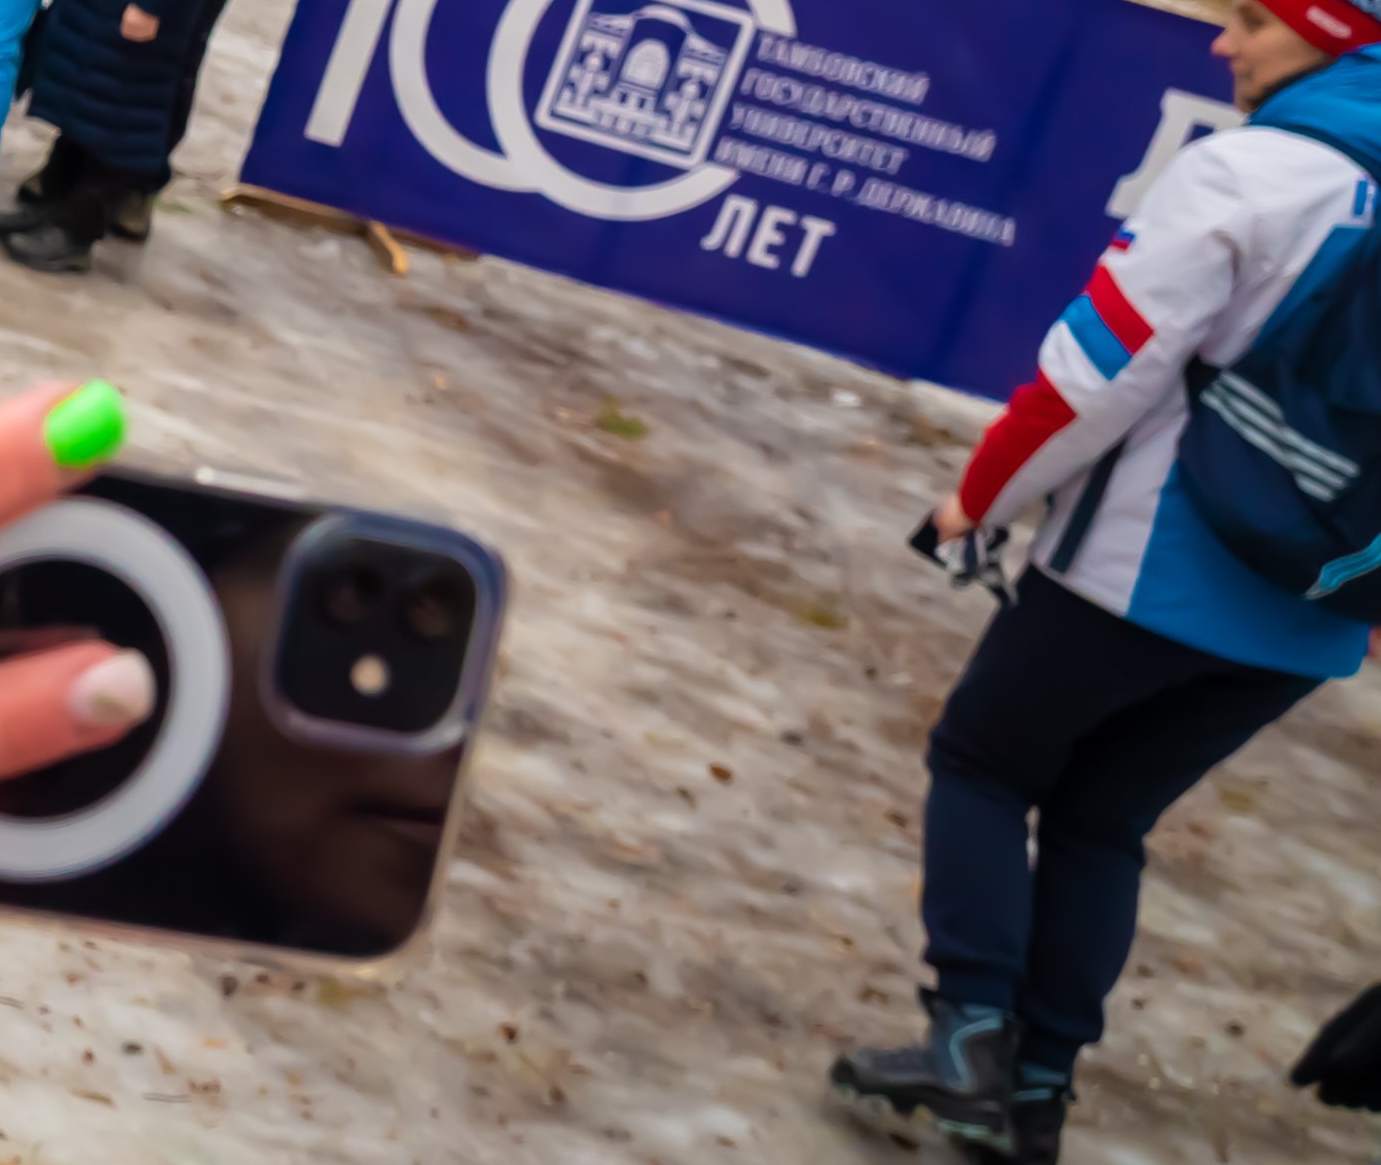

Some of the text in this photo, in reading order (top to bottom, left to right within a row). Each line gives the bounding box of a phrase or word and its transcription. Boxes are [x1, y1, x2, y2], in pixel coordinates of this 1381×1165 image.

[757, 34, 930, 105] ТАМБОВСКИЙ
[729, 102, 910, 175] УНИВЕРСИТЕТ
[741, 68, 996, 163] ГОСУДАРСТВЕННЫЙ
[714, 136, 809, 186] ИМЕНИ
[699, 194, 837, 278] ЛЕТ
